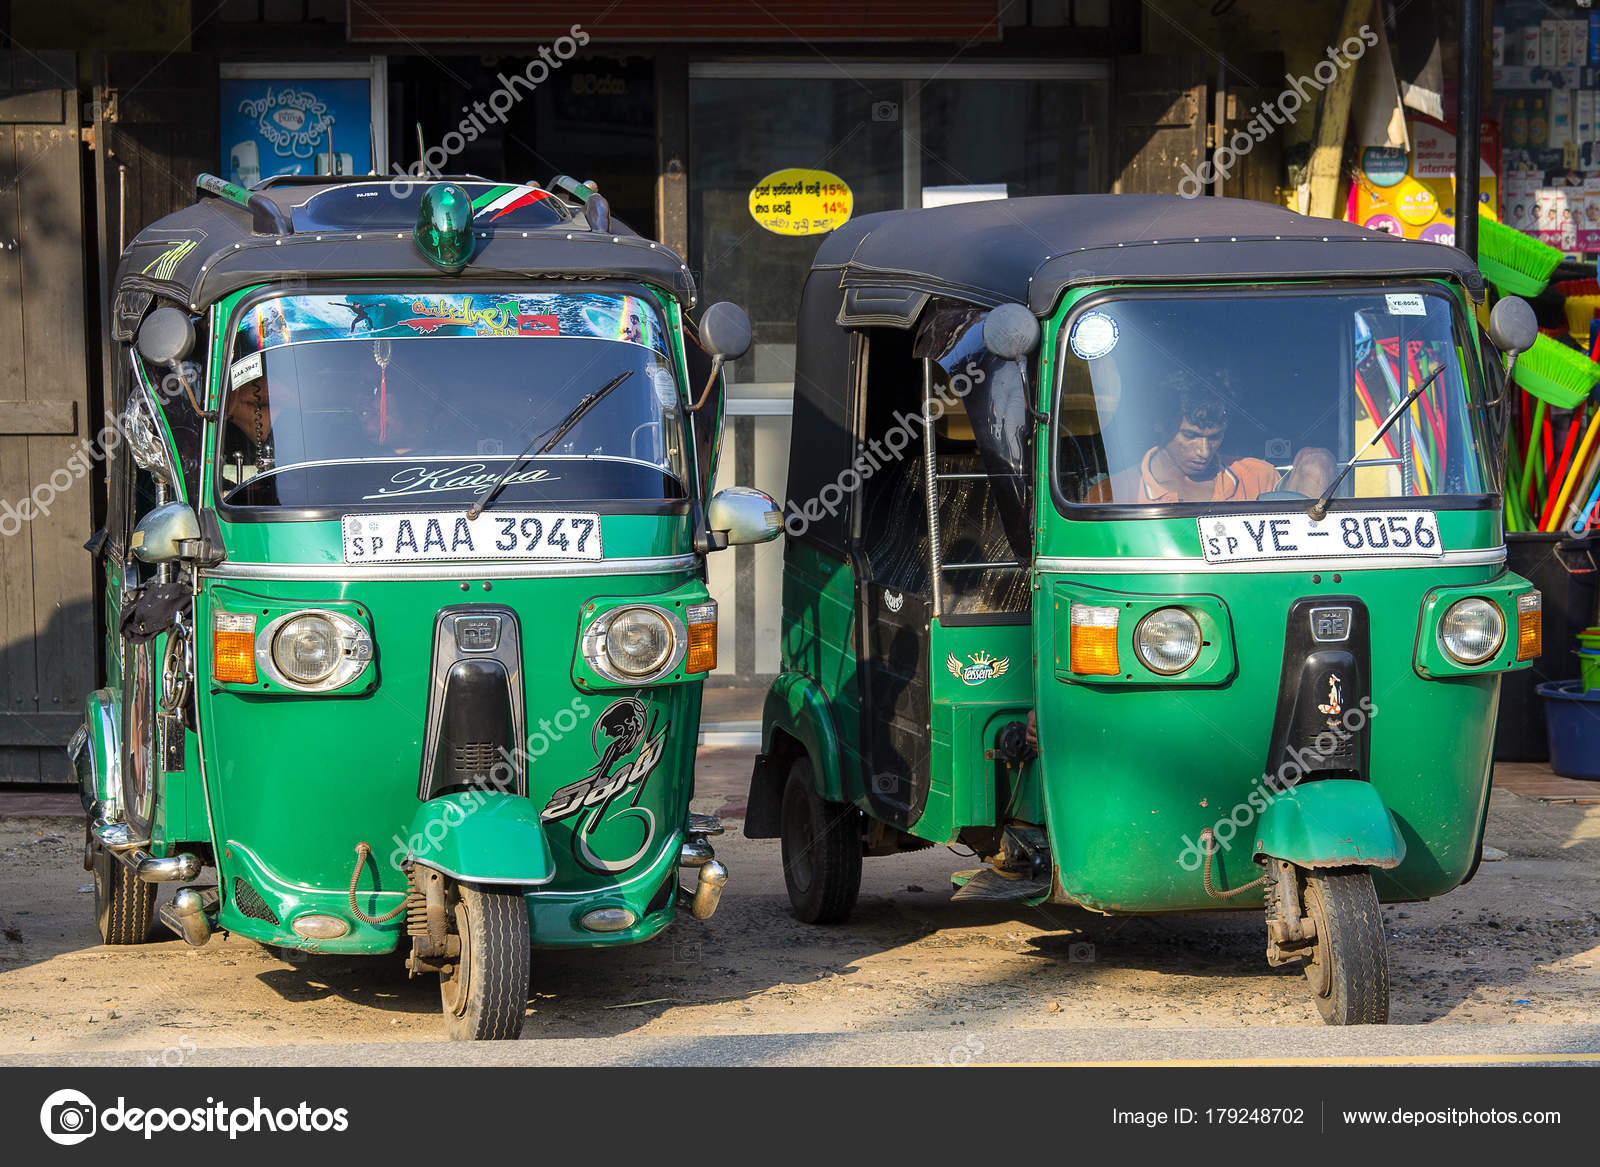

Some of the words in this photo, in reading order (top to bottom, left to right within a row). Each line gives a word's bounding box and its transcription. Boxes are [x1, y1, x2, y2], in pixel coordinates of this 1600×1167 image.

[822, 184, 848, 196] 15%
[822, 202, 848, 214] 14%
[395, 518, 476, 554] AAA
[495, 516, 595, 553] 3947
[1243, 519, 1298, 552] YE
[1340, 516, 1435, 550] 8056
